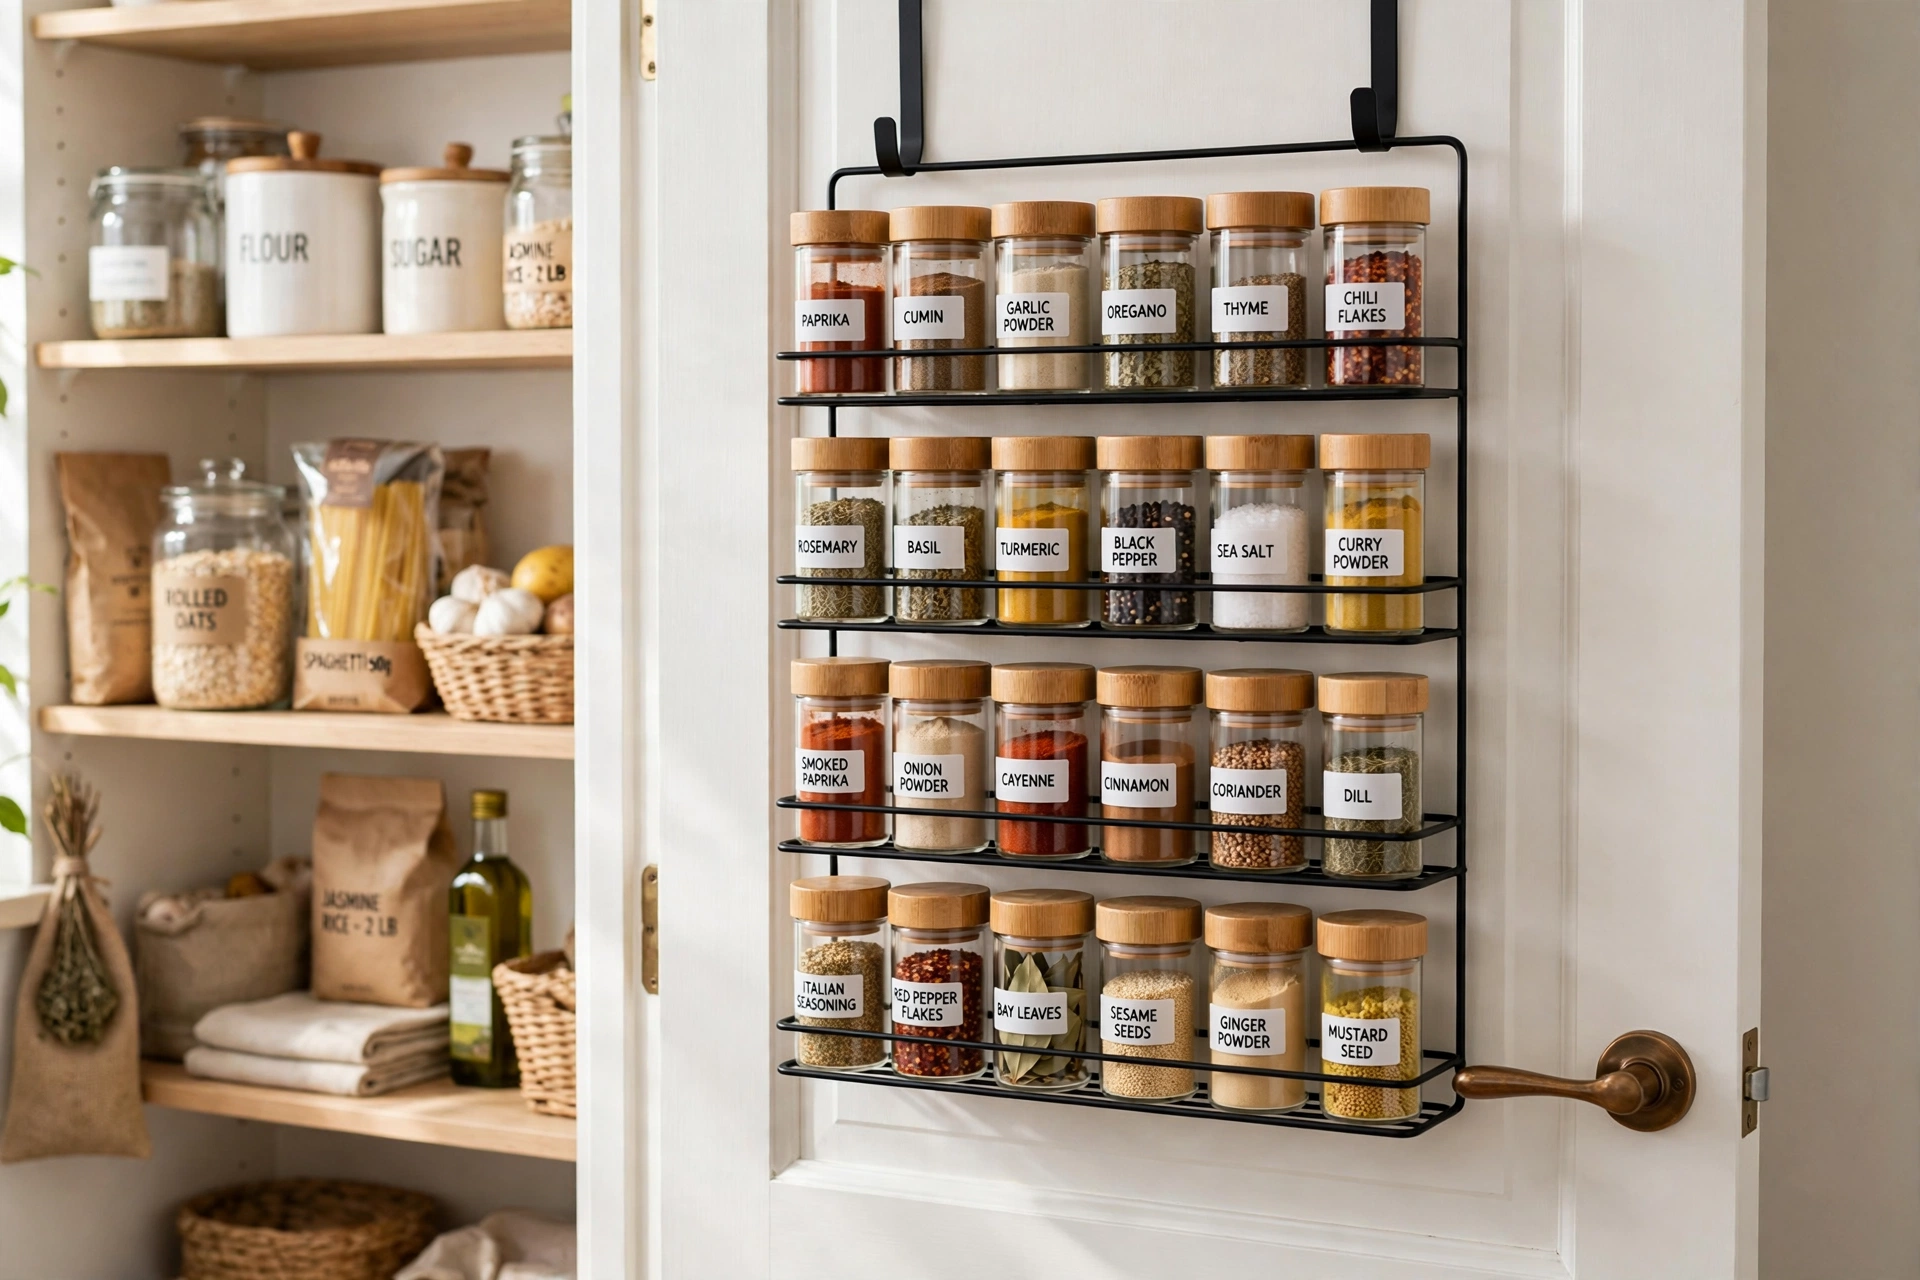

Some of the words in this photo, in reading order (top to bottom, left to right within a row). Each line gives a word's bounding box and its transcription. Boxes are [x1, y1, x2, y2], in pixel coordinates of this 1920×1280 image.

[239, 232, 309, 264] FLOUR
[391, 237, 461, 268] SUGAR
[546, 264, 566, 282] LB
[1344, 291, 1378, 305] CHILI
[1007, 300, 1050, 315] GARLIC
[1107, 304, 1167, 319] OREGANO
[1223, 301, 1269, 316] THYME
[802, 313, 850, 327] PAPRIKA
[904, 310, 944, 324] CUMIN
[1338, 308, 1386, 323] FLAKES
[1003, 317, 1054, 331] POWDER
[798, 540, 858, 553] ROSEMARY
[908, 540, 941, 554] BASIL
[1000, 541, 1060, 556] TURMERIC
[1114, 536, 1155, 550] BLACK
[1338, 537, 1383, 552] CURRY
[1217, 544, 1238, 558] SEA
[1241, 544, 1274, 558] SALT
[1112, 552, 1158, 566] PEPPER
[1333, 555, 1389, 569] POWDER
[175, 611, 217, 632] OATS
[801, 757, 848, 771] SMOKED
[904, 762, 942, 776] ONION
[803, 773, 849, 787] PAPRIKA
[900, 778, 949, 793] POWDER
[1002, 772, 1055, 788] CAYENNE
[1104, 777, 1169, 792] CINNAMON
[1212, 783, 1281, 798] CORIANDER
[1344, 789, 1373, 803] DILL
[322, 889, 379, 912] JASMINE
[322, 913, 349, 935] RICE
[365, 916, 374, 936] 2
[378, 916, 398, 937] LB
[803, 981, 845, 995] ITALIAN
[797, 995, 856, 1011] SEASONING
[894, 987, 910, 1002] RED
[913, 990, 957, 1005] PEPPER
[902, 1006, 943, 1021] FLAKES
[997, 1003, 1014, 1018] BAY
[1017, 1005, 1061, 1020] LEAVES
[1110, 1006, 1157, 1022] SESAME
[1114, 1024, 1151, 1039] SEEDS
[1220, 1016, 1266, 1032] GINGER
[1218, 1032, 1270, 1049] POWDER
[1328, 1024, 1388, 1042] MUSTARD
[1341, 1045, 1373, 1059] SEED
